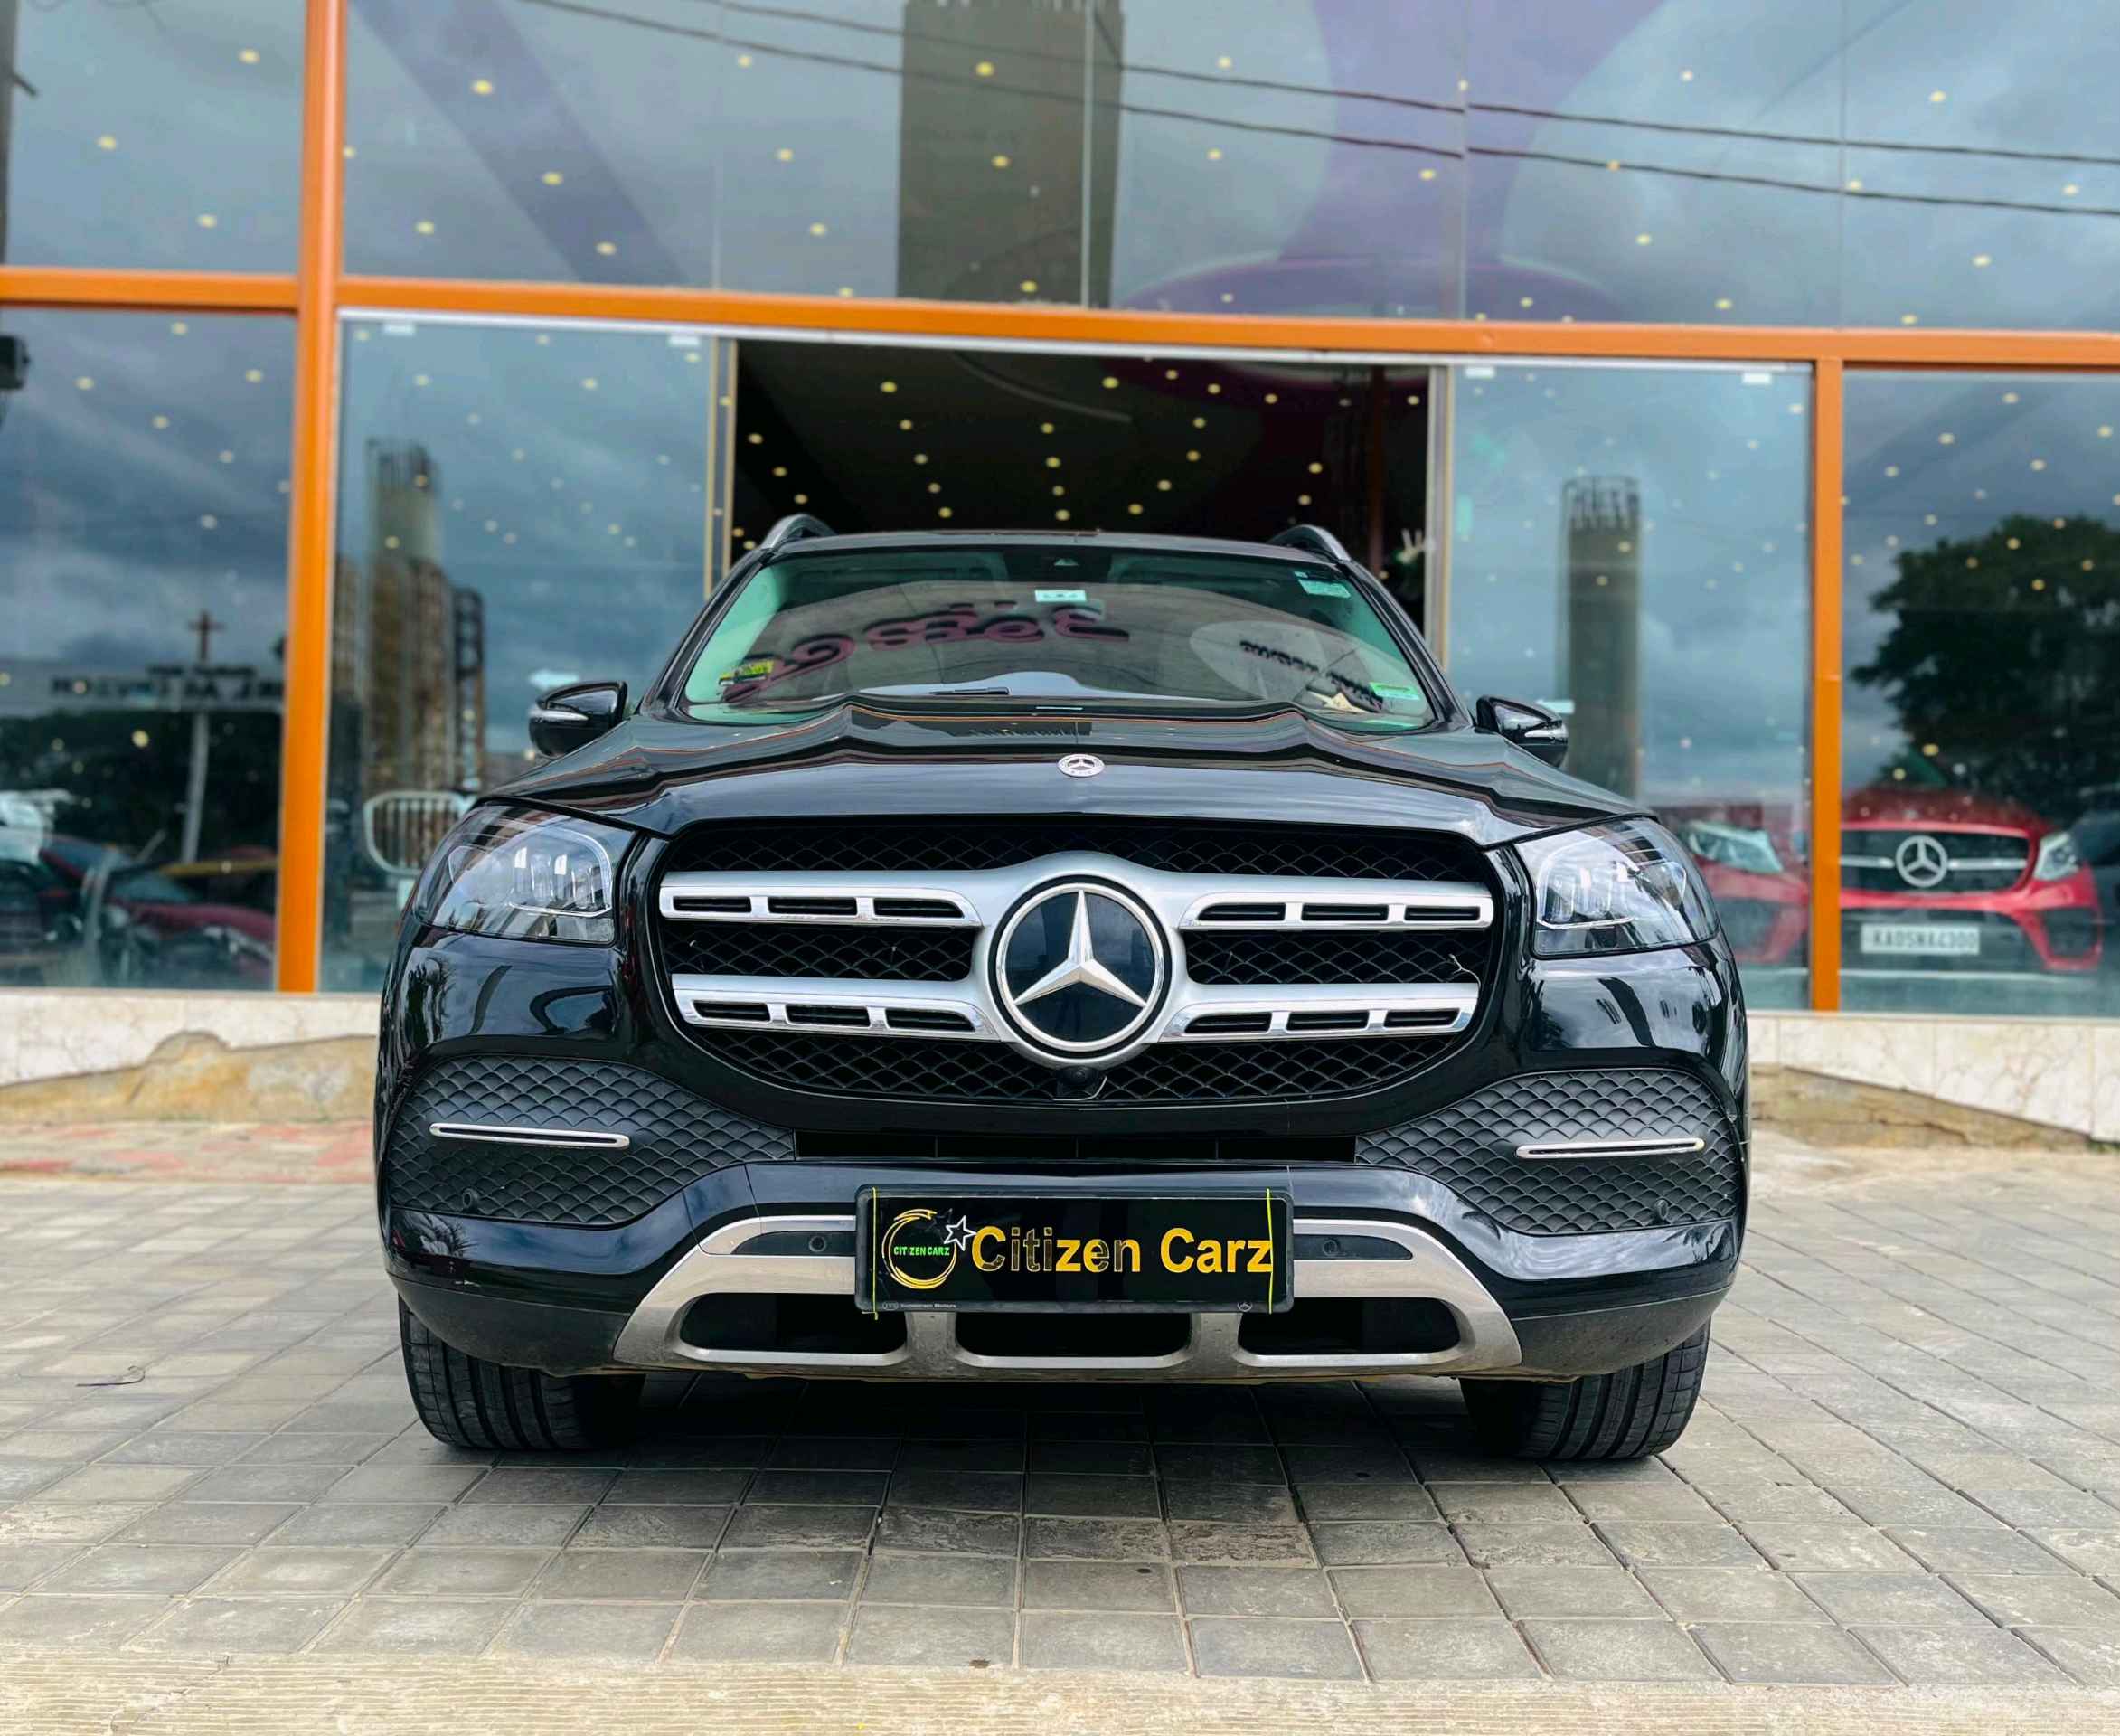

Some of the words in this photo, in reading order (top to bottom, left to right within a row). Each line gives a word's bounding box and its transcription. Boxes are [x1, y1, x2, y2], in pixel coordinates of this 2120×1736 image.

[893, 1246, 926, 1256] CITZEN
[927, 1246, 950, 1256] CARZ
[972, 1226, 1141, 1273] Citizen
[1161, 1228, 1274, 1273] Carz
